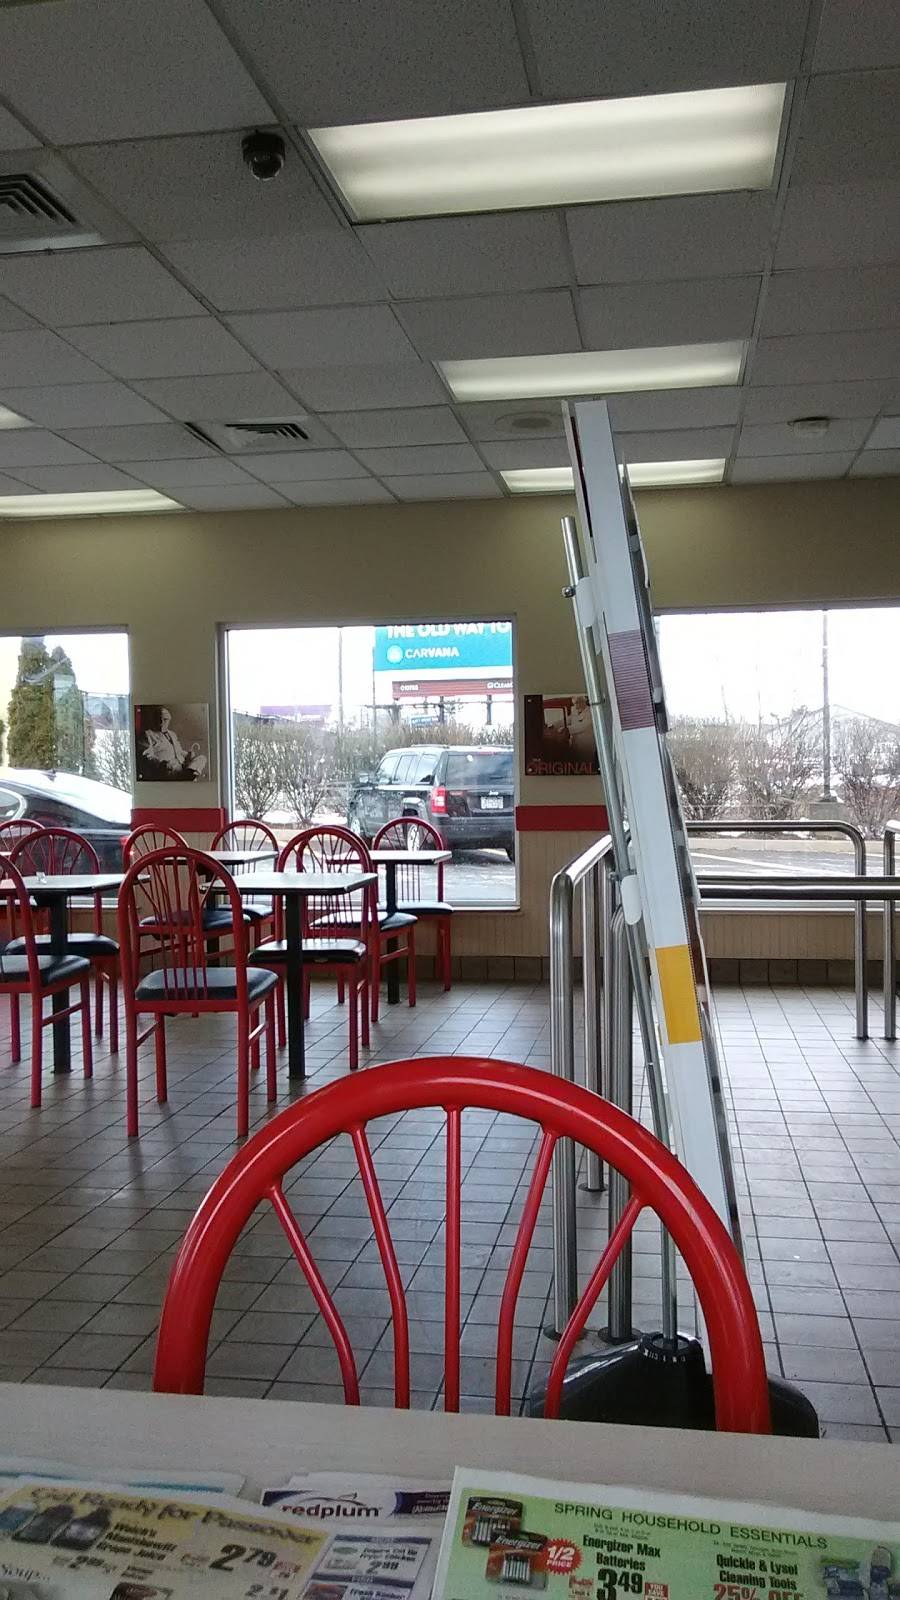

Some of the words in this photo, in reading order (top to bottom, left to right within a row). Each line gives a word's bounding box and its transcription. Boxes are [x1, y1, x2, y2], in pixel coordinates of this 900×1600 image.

[387, 625, 415, 639] THE
[417, 624, 451, 638] OLD
[453, 623, 485, 636] WAY
[405, 647, 460, 659] CARVANA
[527, 761, 594, 775] ORIGINAL
[281, 1503, 380, 1519] redplum
[554, 1502, 613, 1520] SPRING
[622, 1511, 721, 1535] HOUSEHOLD
[730, 1525, 828, 1549] ESSENTIALS
[495, 1535, 544, 1550] Energizer
[583, 1534, 633, 1553] Energizer
[637, 1542, 661, 1558] Max
[547, 1545, 576, 1561] 1/2
[546, 1559, 572, 1568] PRICE
[596, 1552, 646, 1571] Batteries
[716, 1553, 756, 1570] Quickie
[759, 1559, 768, 1572] &
[770, 1561, 798, 1576] Lysol
[719, 1570, 766, 1588] Cleaning
[768, 1576, 797, 1590] Tools
